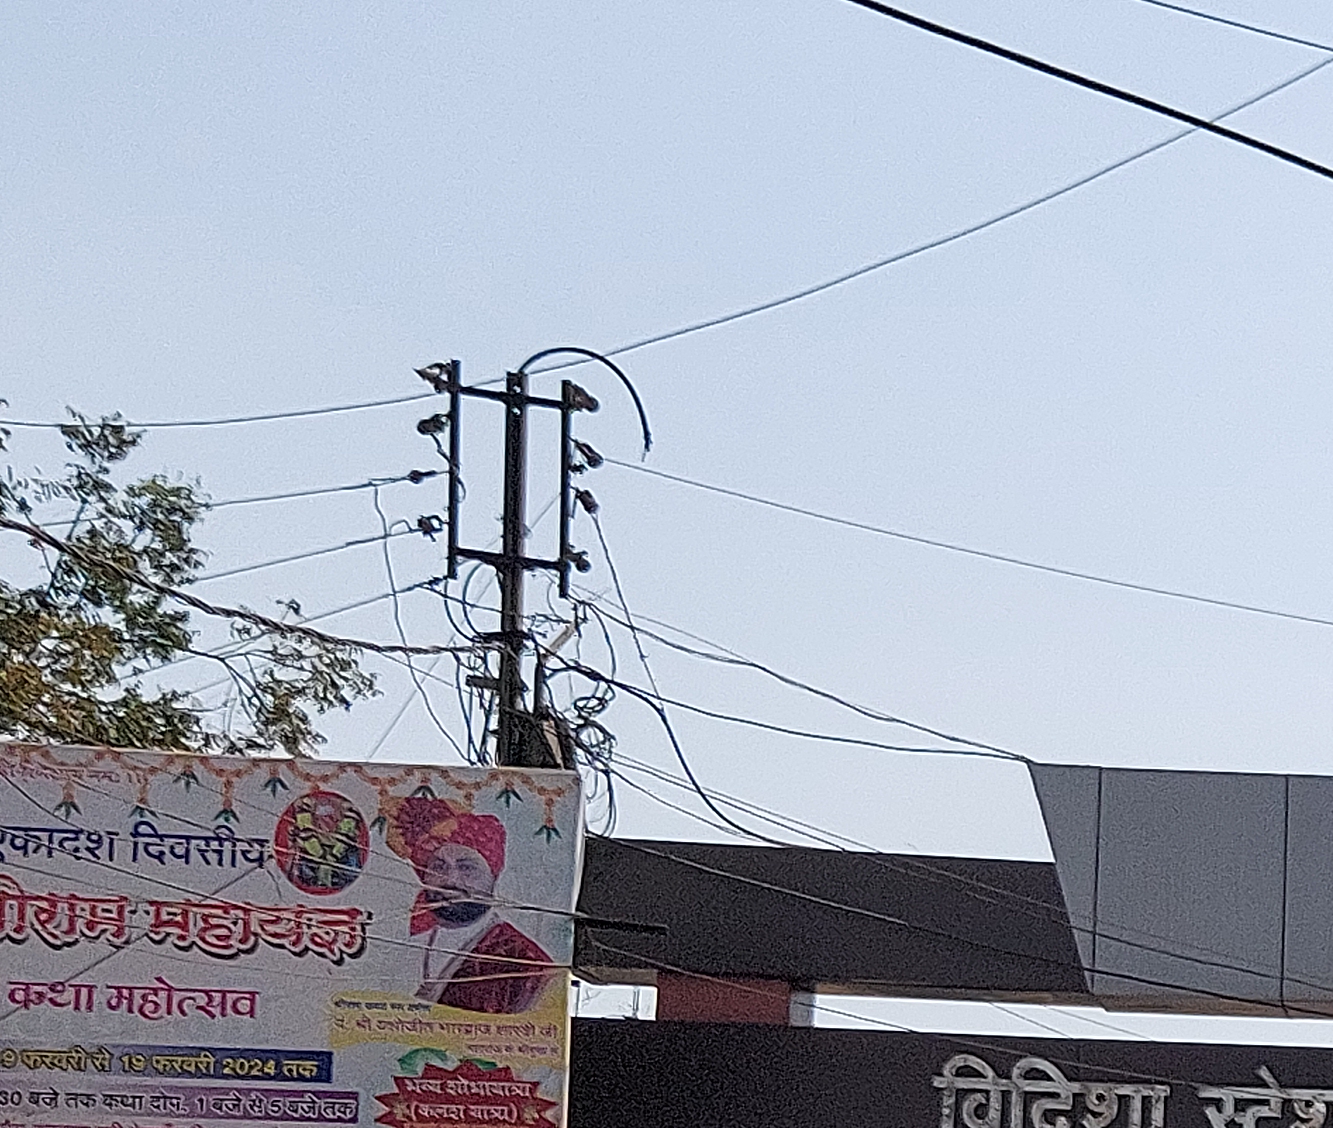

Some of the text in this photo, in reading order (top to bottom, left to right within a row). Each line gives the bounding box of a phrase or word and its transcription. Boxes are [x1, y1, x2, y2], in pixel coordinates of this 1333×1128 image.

[131, 821, 270, 868] दिवसीय
[7, 976, 259, 1020] कथा महोत्सव
[20, 1044, 87, 1071] फरवरी
[91, 1046, 112, 1071] से
[121, 1055, 146, 1071] 19
[151, 1052, 215, 1077] फरवरी
[222, 1058, 275, 1077] 2024
[282, 1060, 318, 1079] तक
[65, 1092, 96, 1109] तक
[211, 1091, 243, 1115] बजे
[248, 1092, 265, 1115] से
[268, 1098, 282, 1115] 5
[285, 1093, 319, 1117] बजे
[321, 1098, 356, 1119] तक
